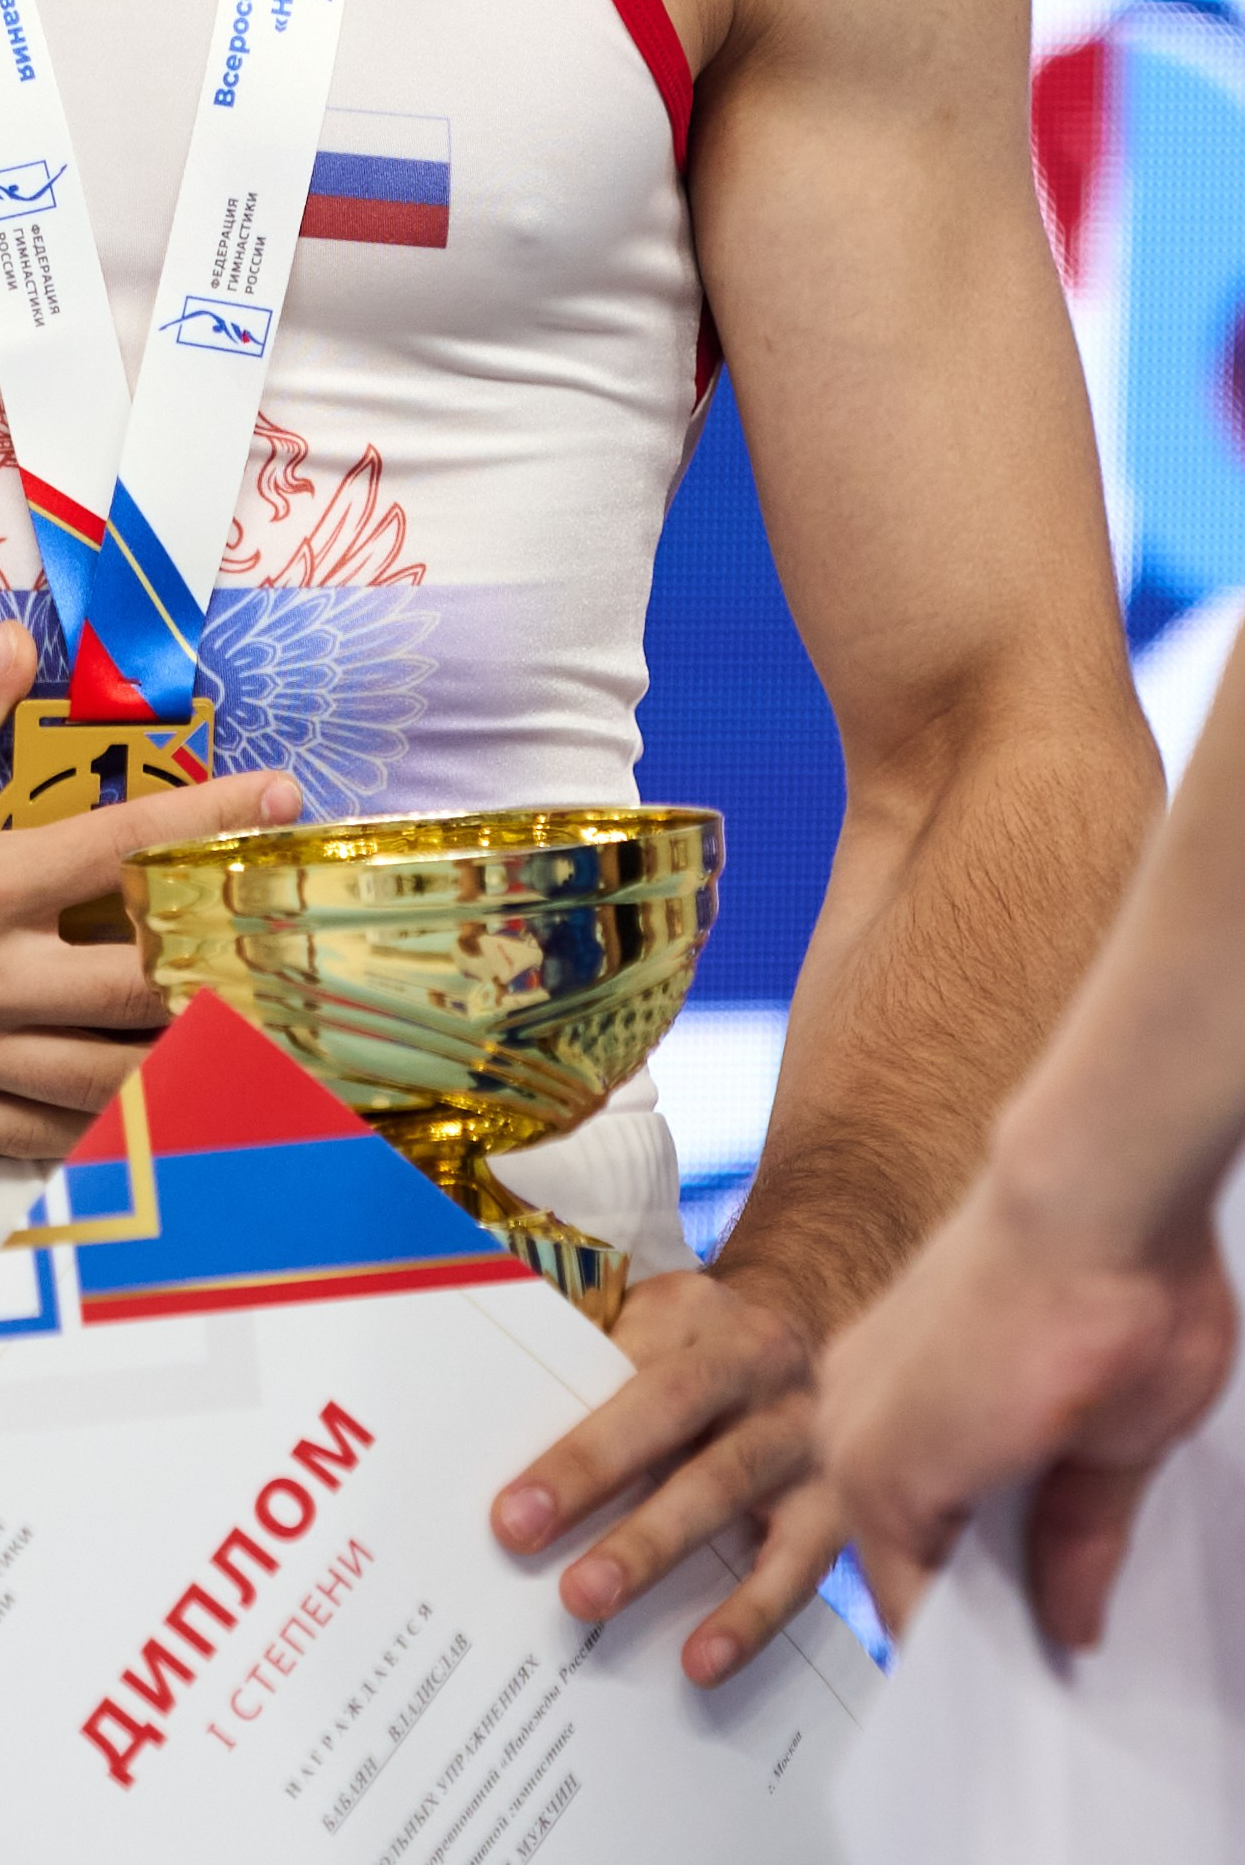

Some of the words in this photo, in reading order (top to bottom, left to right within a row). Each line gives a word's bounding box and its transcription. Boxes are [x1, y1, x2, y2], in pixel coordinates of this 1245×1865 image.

[13, 228, 45, 327] ГИМНАСТИКИ
[30, 223, 60, 315] ФЕДЕРАЦИЯ
[211, 197, 239, 289] ФЕДЕРАЦИЯ
[227, 192, 258, 291] ГИМНАСТИКИ
[245, 236, 266, 294] РОССИИ
[90, 744, 128, 810] 1
[80, 1399, 375, 1791] ДИПЛОМ
[229, 1538, 375, 1722] СТЕПЕНИ
[284, 1603, 434, 1800] НАГРАЖДАЕТСЯ
[322, 1757, 378, 1833] БАБАЯН
[388, 1633, 468, 1743] ВЛАДИСЛАВ
[436, 1652, 539, 1796] УПРАЖНЕНИЯХ
[773, 1731, 802, 1778] Москва
[516, 1773, 577, 1861] МУЖЧИН
